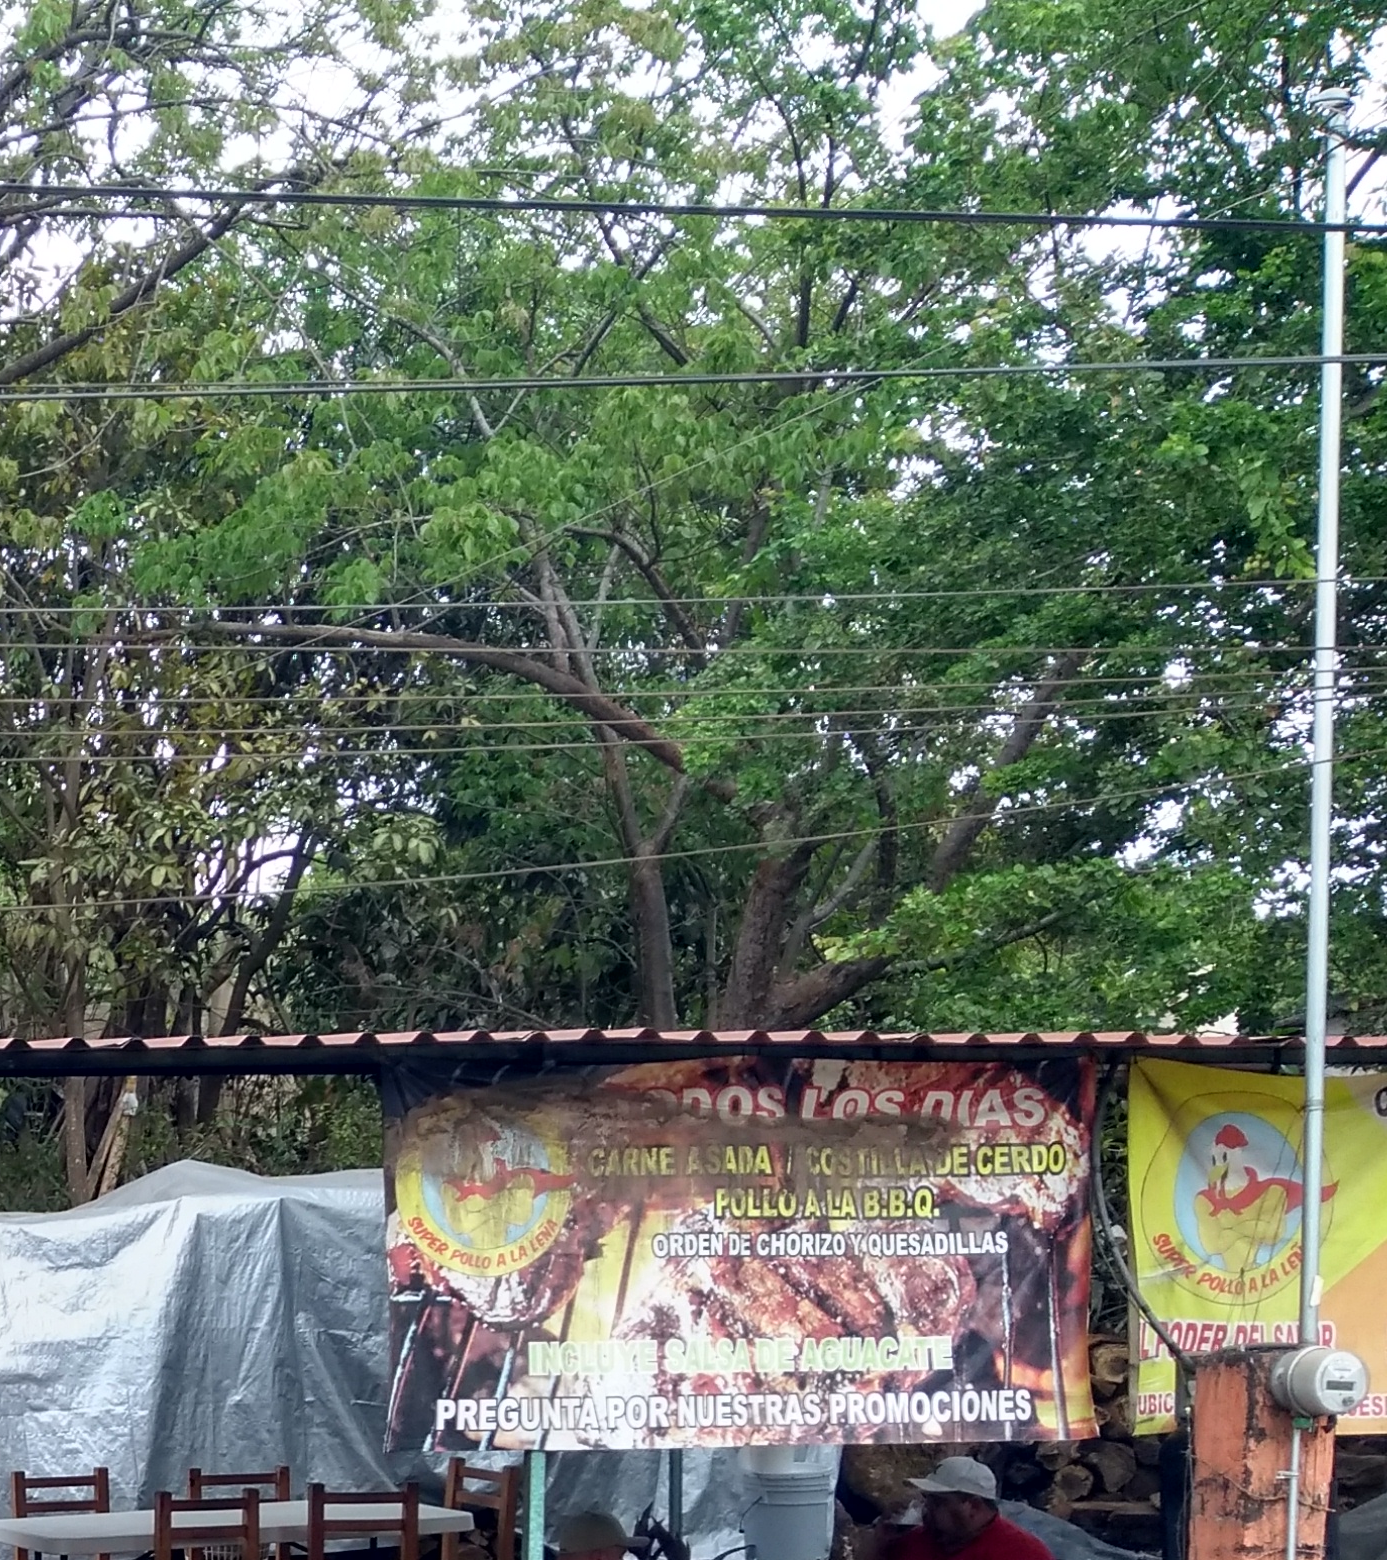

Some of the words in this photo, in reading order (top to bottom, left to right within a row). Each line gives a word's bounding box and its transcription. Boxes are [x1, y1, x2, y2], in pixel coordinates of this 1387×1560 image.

[611, 1085, 785, 1125] DOS
[588, 1146, 676, 1176] CARNE
[685, 1144, 773, 1175] ASADA
[935, 1144, 969, 1176] DE
[977, 1143, 1066, 1175] CERDO
[715, 1188, 797, 1218] POLLO
[804, 1189, 821, 1217] A
[827, 1188, 857, 1218] LA
[864, 1186, 940, 1218] B.B.Q.
[408, 1217, 450, 1255] SUPER
[449, 1248, 492, 1270] POLLO
[497, 1253, 506, 1267] A
[511, 1247, 528, 1263] LA
[531, 1218, 558, 1254] LEÑA
[652, 1232, 723, 1258] ORDEN
[728, 1232, 752, 1258] DE
[756, 1232, 846, 1257] CHORIZO
[848, 1233, 862, 1256] Y
[868, 1230, 1009, 1257] QUESADILLAS
[1153, 1233, 1197, 1279] SUPER
[1196, 1272, 1244, 1295] POLLO
[1249, 1279, 1259, 1293] A
[1261, 1268, 1280, 1288] LA
[1281, 1241, 1303, 1276] LEÑ
[527, 1340, 659, 1376] INCLUYE
[664, 1338, 752, 1374] SALSA
[755, 1338, 796, 1372] DE
[799, 1336, 954, 1371] AGUACATE
[435, 1398, 600, 1432] PREGUNTA
[607, 1397, 670, 1430] POR
[678, 1393, 822, 1428] NUESTRAS
[1138, 1392, 1174, 1415] UBIC
